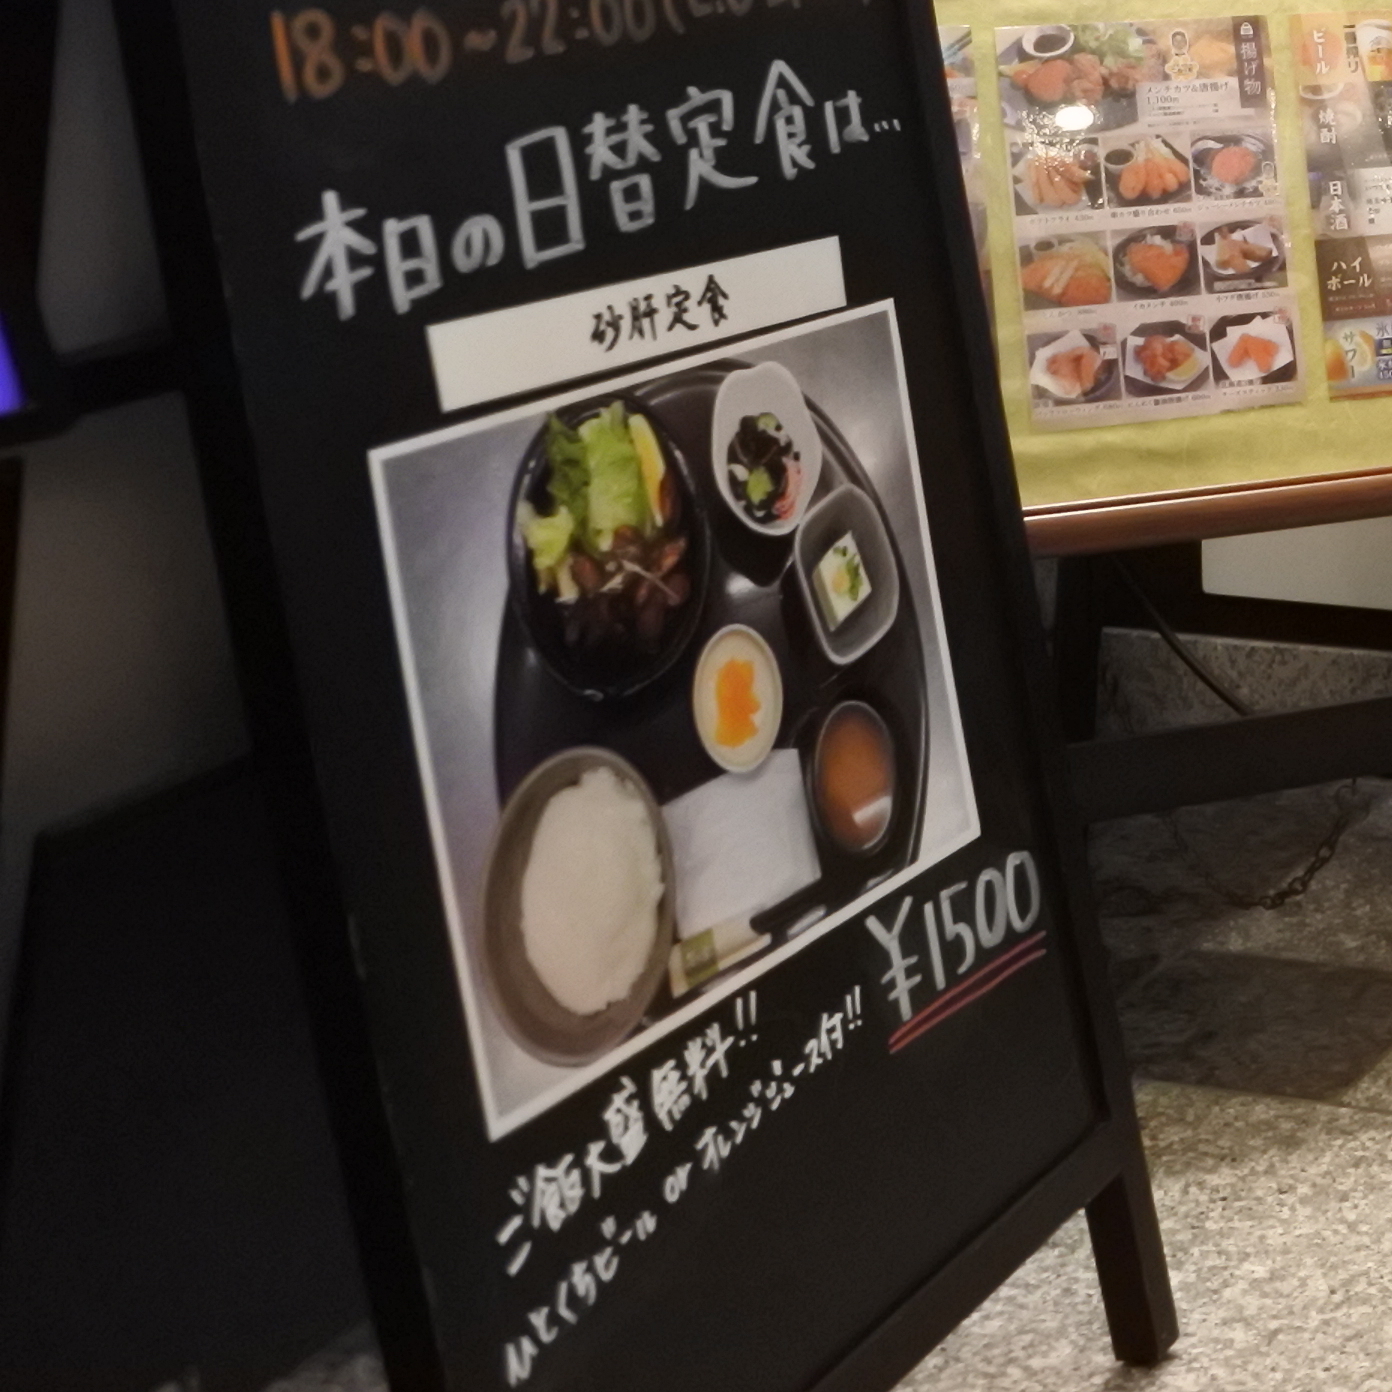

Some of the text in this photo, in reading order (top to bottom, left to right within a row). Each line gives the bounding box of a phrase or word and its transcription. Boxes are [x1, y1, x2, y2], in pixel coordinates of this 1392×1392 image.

[1240, 41, 1262, 95] 揚げ物
[1312, 27, 1330, 75] ビール
[1318, 108, 1338, 145] 焼酎
[1328, 179, 1348, 231] 日本酒
[590, 272, 731, 354] 砂肝定食
[1342, 331, 1358, 379] サワー
[865, 849, 1041, 1021] ¥1500
[662, 1161, 692, 1203] or
